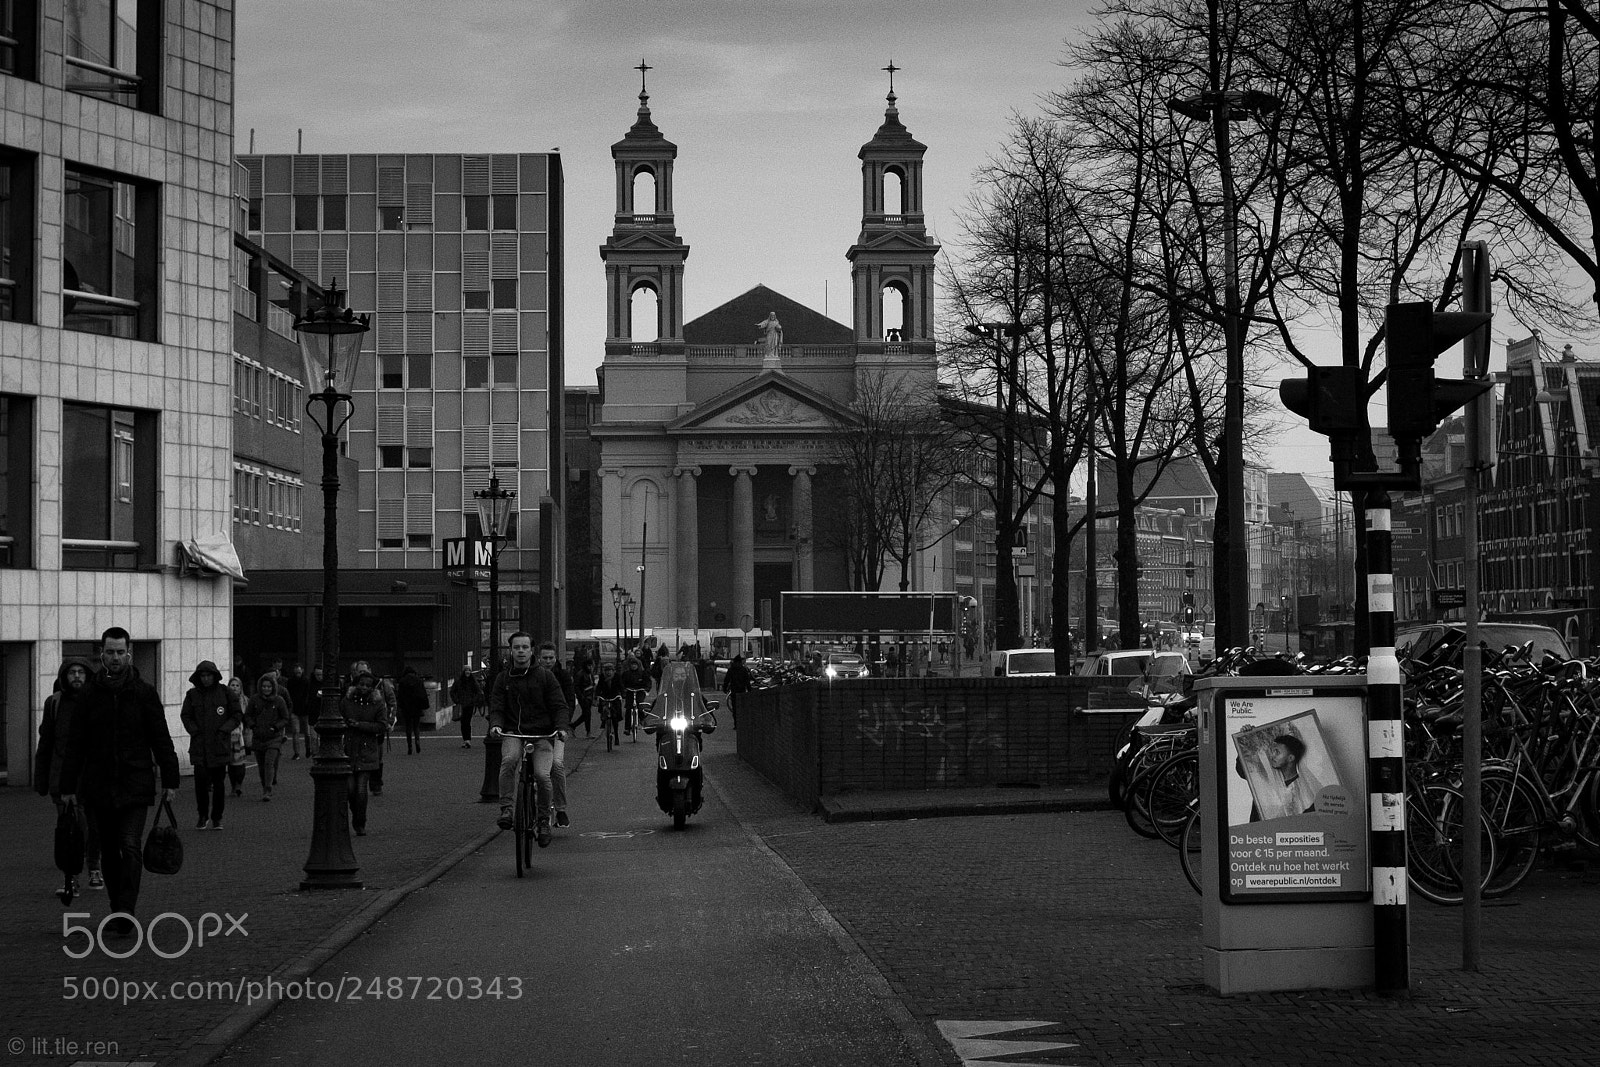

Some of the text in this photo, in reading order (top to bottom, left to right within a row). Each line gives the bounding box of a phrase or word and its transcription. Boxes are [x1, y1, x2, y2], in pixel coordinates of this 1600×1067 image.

[447, 540, 465, 566] M
[474, 540, 493, 566] M
[1230, 834, 1320, 845] De beste exposities
[1230, 847, 1330, 860] voor € 15 per maand.
[1230, 861, 1350, 872] Ontdek nu hoe het werkt
[1230, 876, 1338, 888] op wearepublic.nl/ontdek
